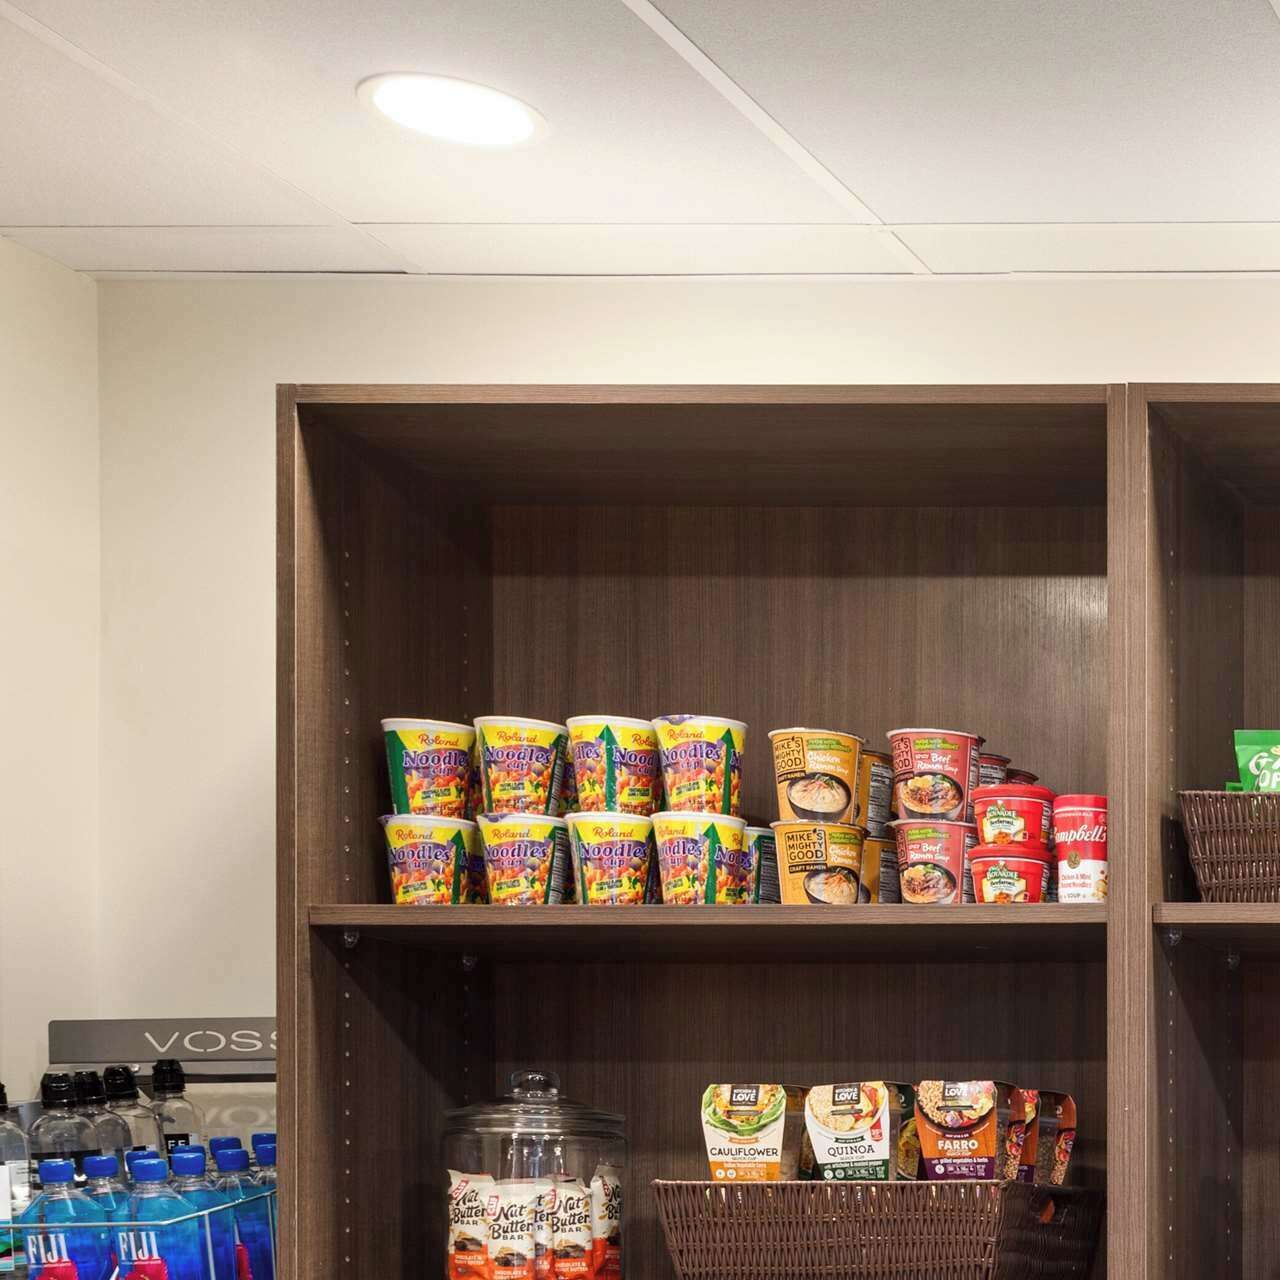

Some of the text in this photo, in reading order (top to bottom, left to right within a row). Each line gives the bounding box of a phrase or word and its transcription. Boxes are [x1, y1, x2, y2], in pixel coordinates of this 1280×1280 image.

[419, 733, 459, 748] Roland
[496, 730, 538, 744] Roland
[668, 728, 704, 742] Roland
[484, 745, 551, 766] Noodles
[931, 752, 952, 764] Beef
[777, 759, 802, 772] GOOD
[396, 828, 433, 841] Roland
[492, 828, 530, 840] Roland
[593, 826, 634, 839] Roland
[787, 828, 823, 842] MIKE'S
[579, 842, 648, 861] Noodles
[788, 841, 823, 851] MIGHTY
[922, 842, 943, 853] Beef
[789, 849, 823, 861] GOOD
[732, 1093, 756, 1101] LOVE
[835, 1092, 858, 1101] LOVE
[828, 1145, 875, 1156] QUINOA
[938, 1140, 978, 1149] FARRO
[710, 1147, 778, 1157] CAULIFLOWER
[557, 1196, 584, 1214] Nut
[452, 1206, 487, 1226] Butter
[498, 1204, 528, 1222] Nut
[551, 1213, 591, 1233] Butter
[488, 1222, 535, 1241] Butter
[502, 1233, 524, 1241] BAR
[27, 1233, 69, 1264] FIJI
[117, 1231, 160, 1262] FIJI
